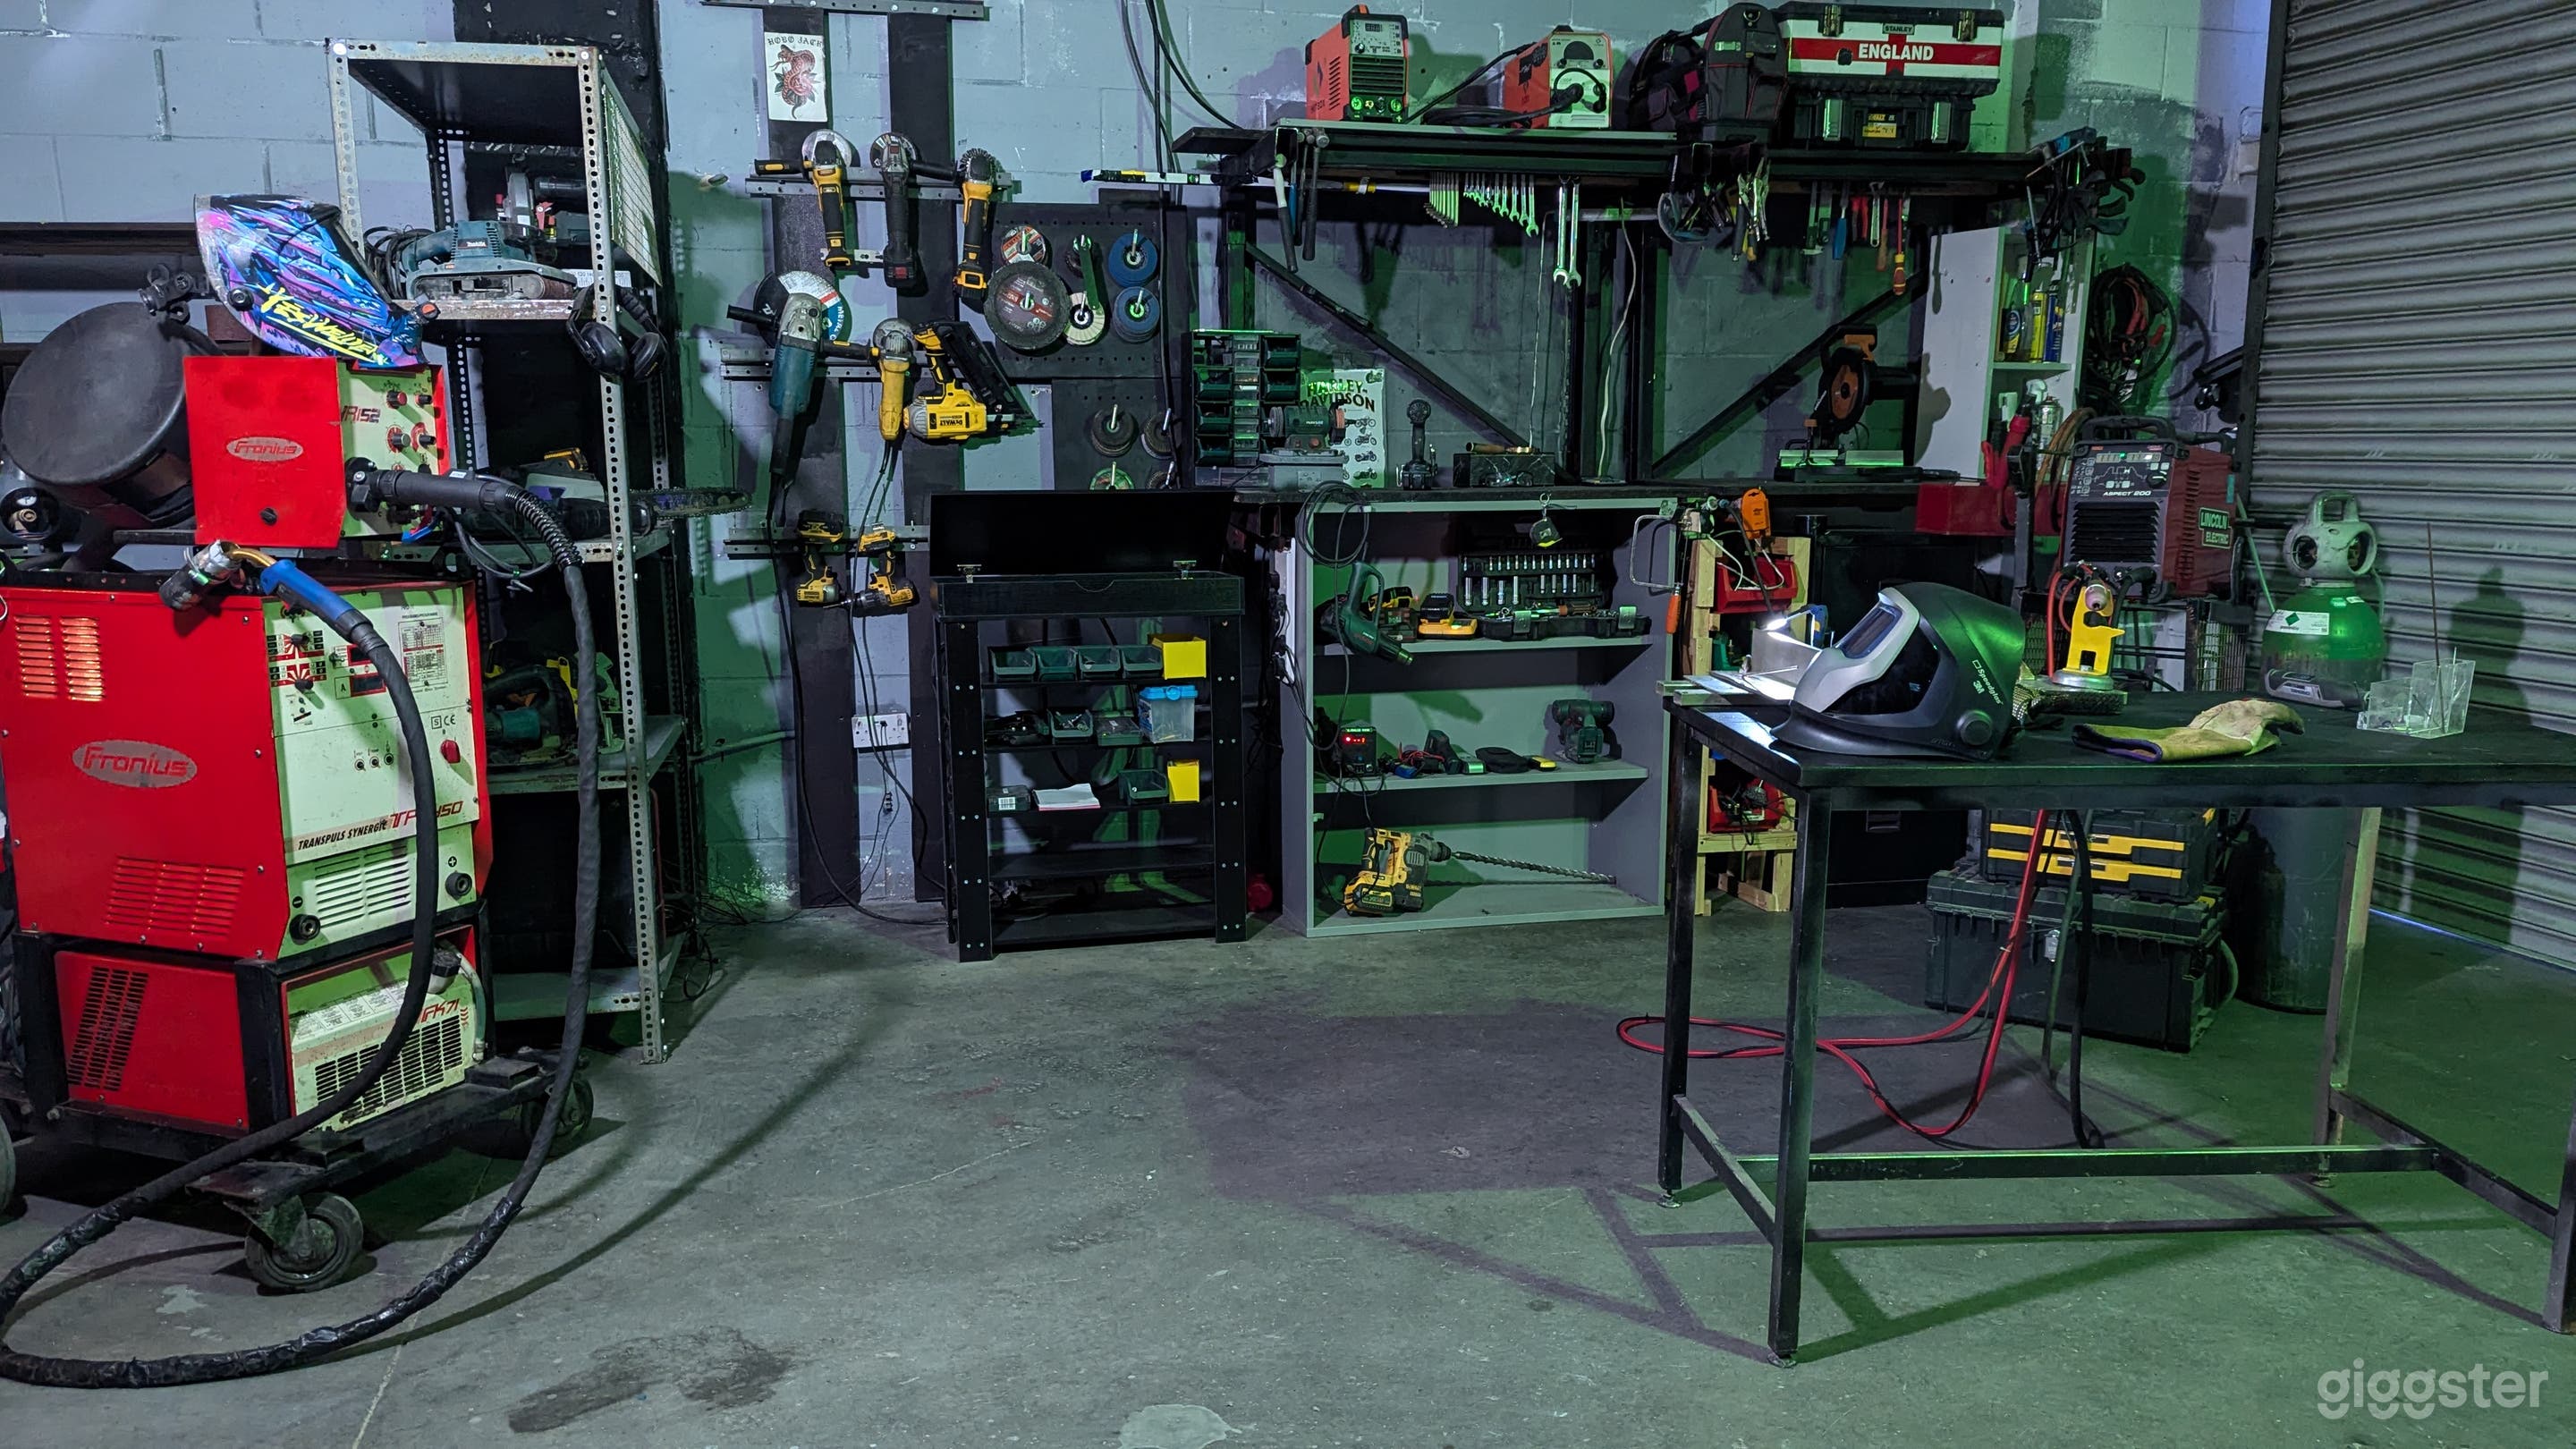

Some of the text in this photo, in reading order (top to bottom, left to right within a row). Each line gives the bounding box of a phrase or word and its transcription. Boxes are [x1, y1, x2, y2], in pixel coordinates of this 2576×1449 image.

[767, 36, 794, 46] HOBO
[1858, 43, 1934, 61] ENGLAND
[234, 441, 297, 454] Fronius
[2200, 513, 2229, 530] LINCOLN
[2206, 531, 2229, 545] ELECTRIC
[1973, 680, 1985, 694] 3M
[82, 746, 190, 777] Fronius
[298, 831, 345, 851] TRANSPULS
[347, 818, 388, 840] SYNERGIC
